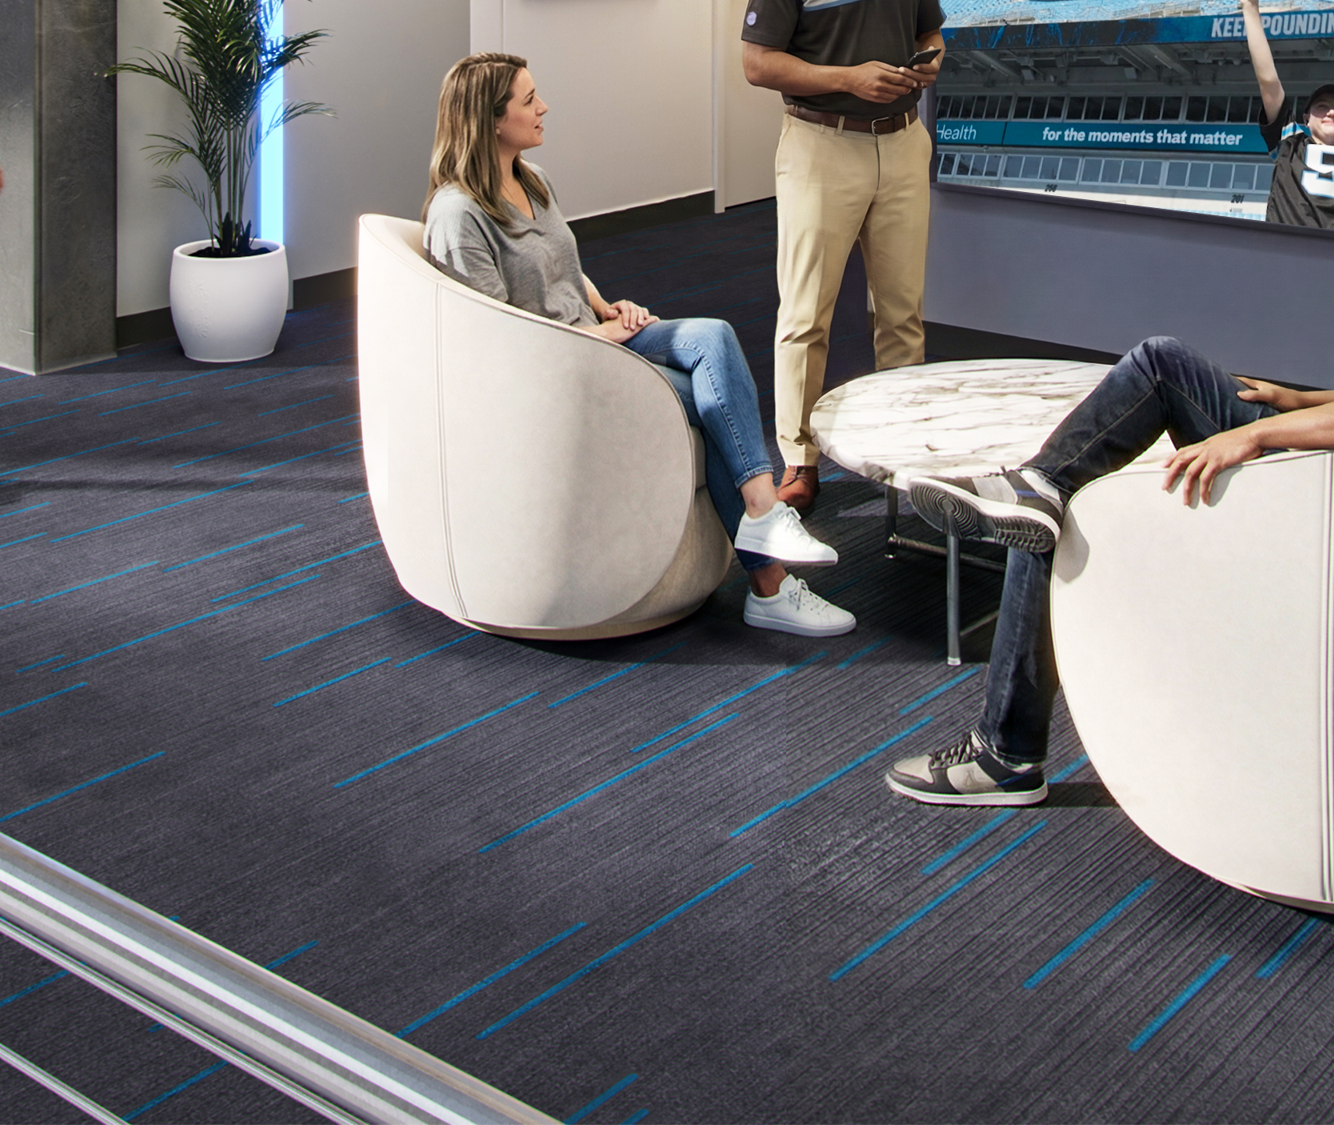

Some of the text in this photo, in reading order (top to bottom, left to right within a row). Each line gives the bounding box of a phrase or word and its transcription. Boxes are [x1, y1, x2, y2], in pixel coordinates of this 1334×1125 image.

[937, 124, 977, 140] Health
[1042, 127, 1243, 146] for the moments that matter
